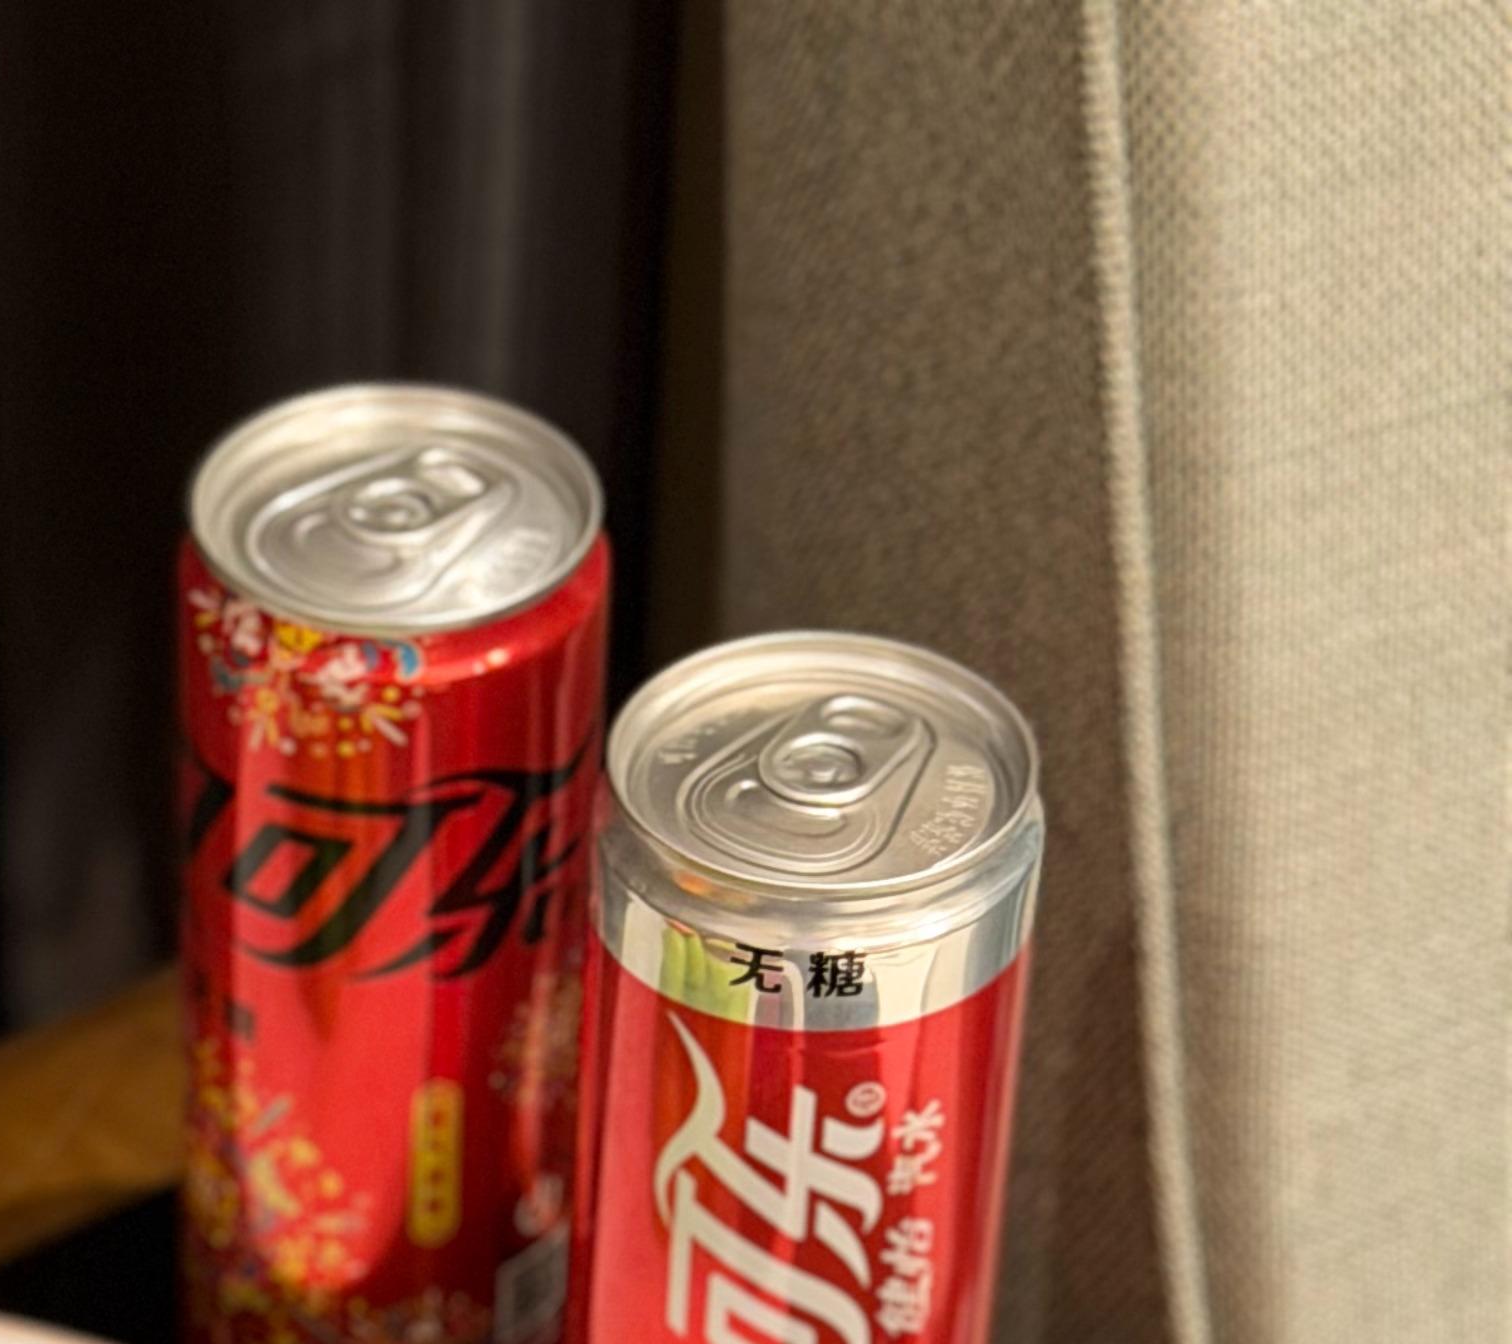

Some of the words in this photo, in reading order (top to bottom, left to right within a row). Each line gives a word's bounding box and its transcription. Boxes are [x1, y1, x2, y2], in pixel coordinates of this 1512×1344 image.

[728, 941, 867, 998] 无糖
[888, 1099, 945, 1196] 汽水
[875, 1218, 934, 1337] 健怡
